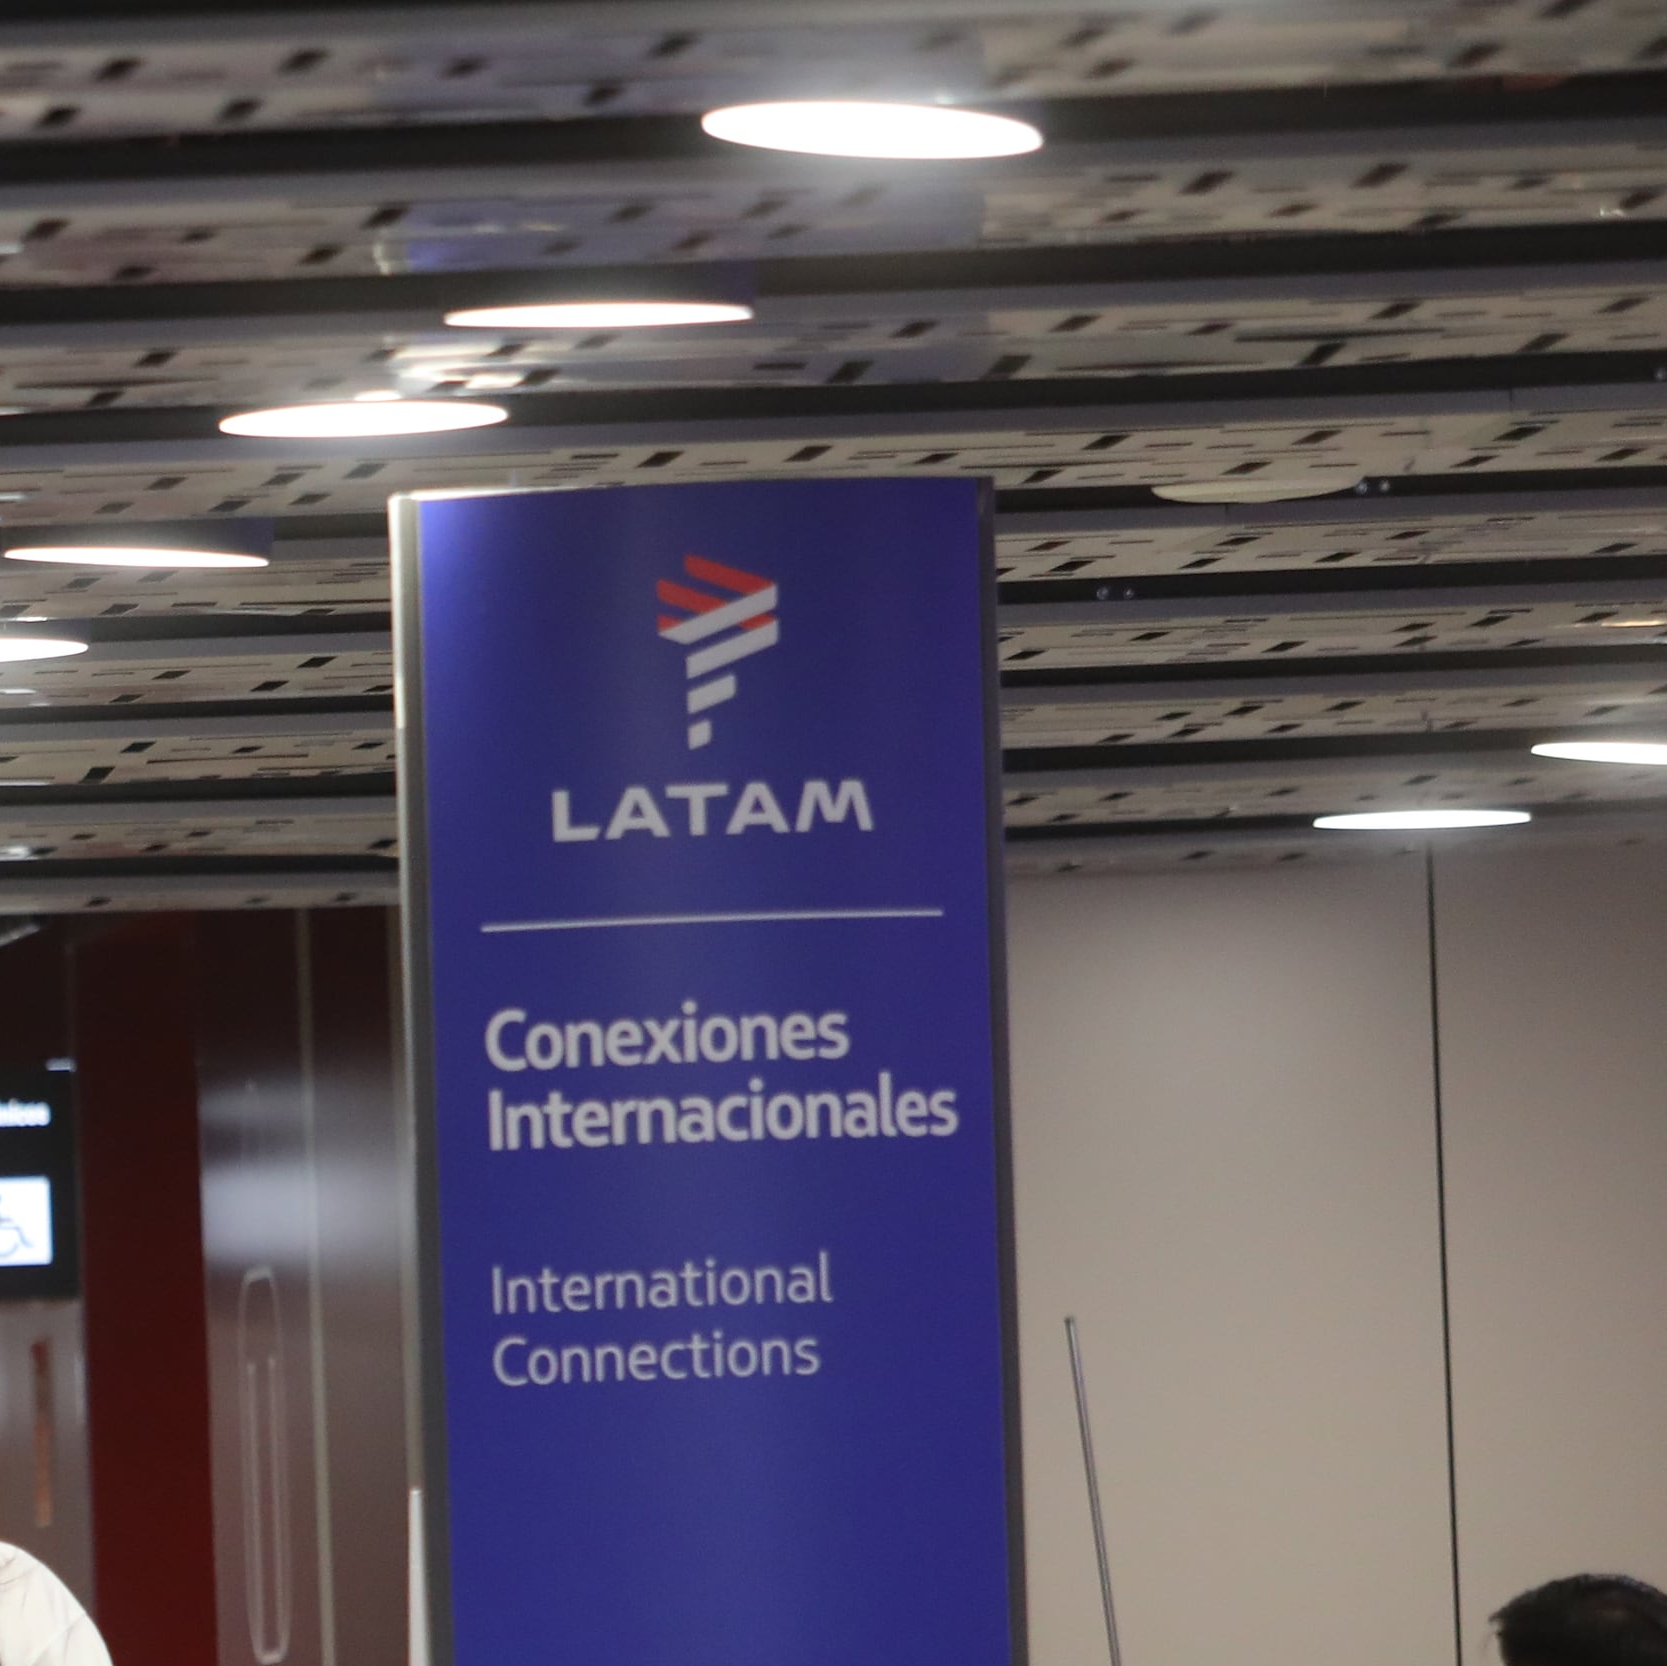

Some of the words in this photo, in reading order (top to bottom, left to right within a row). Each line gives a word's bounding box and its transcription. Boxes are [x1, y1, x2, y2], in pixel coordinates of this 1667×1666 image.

[551, 779, 874, 843] LATAM
[485, 1000, 851, 1072] Conexiones
[487, 1070, 960, 1152] Internacionales
[492, 1249, 834, 1315] International
[492, 1329, 821, 1387] Connections
